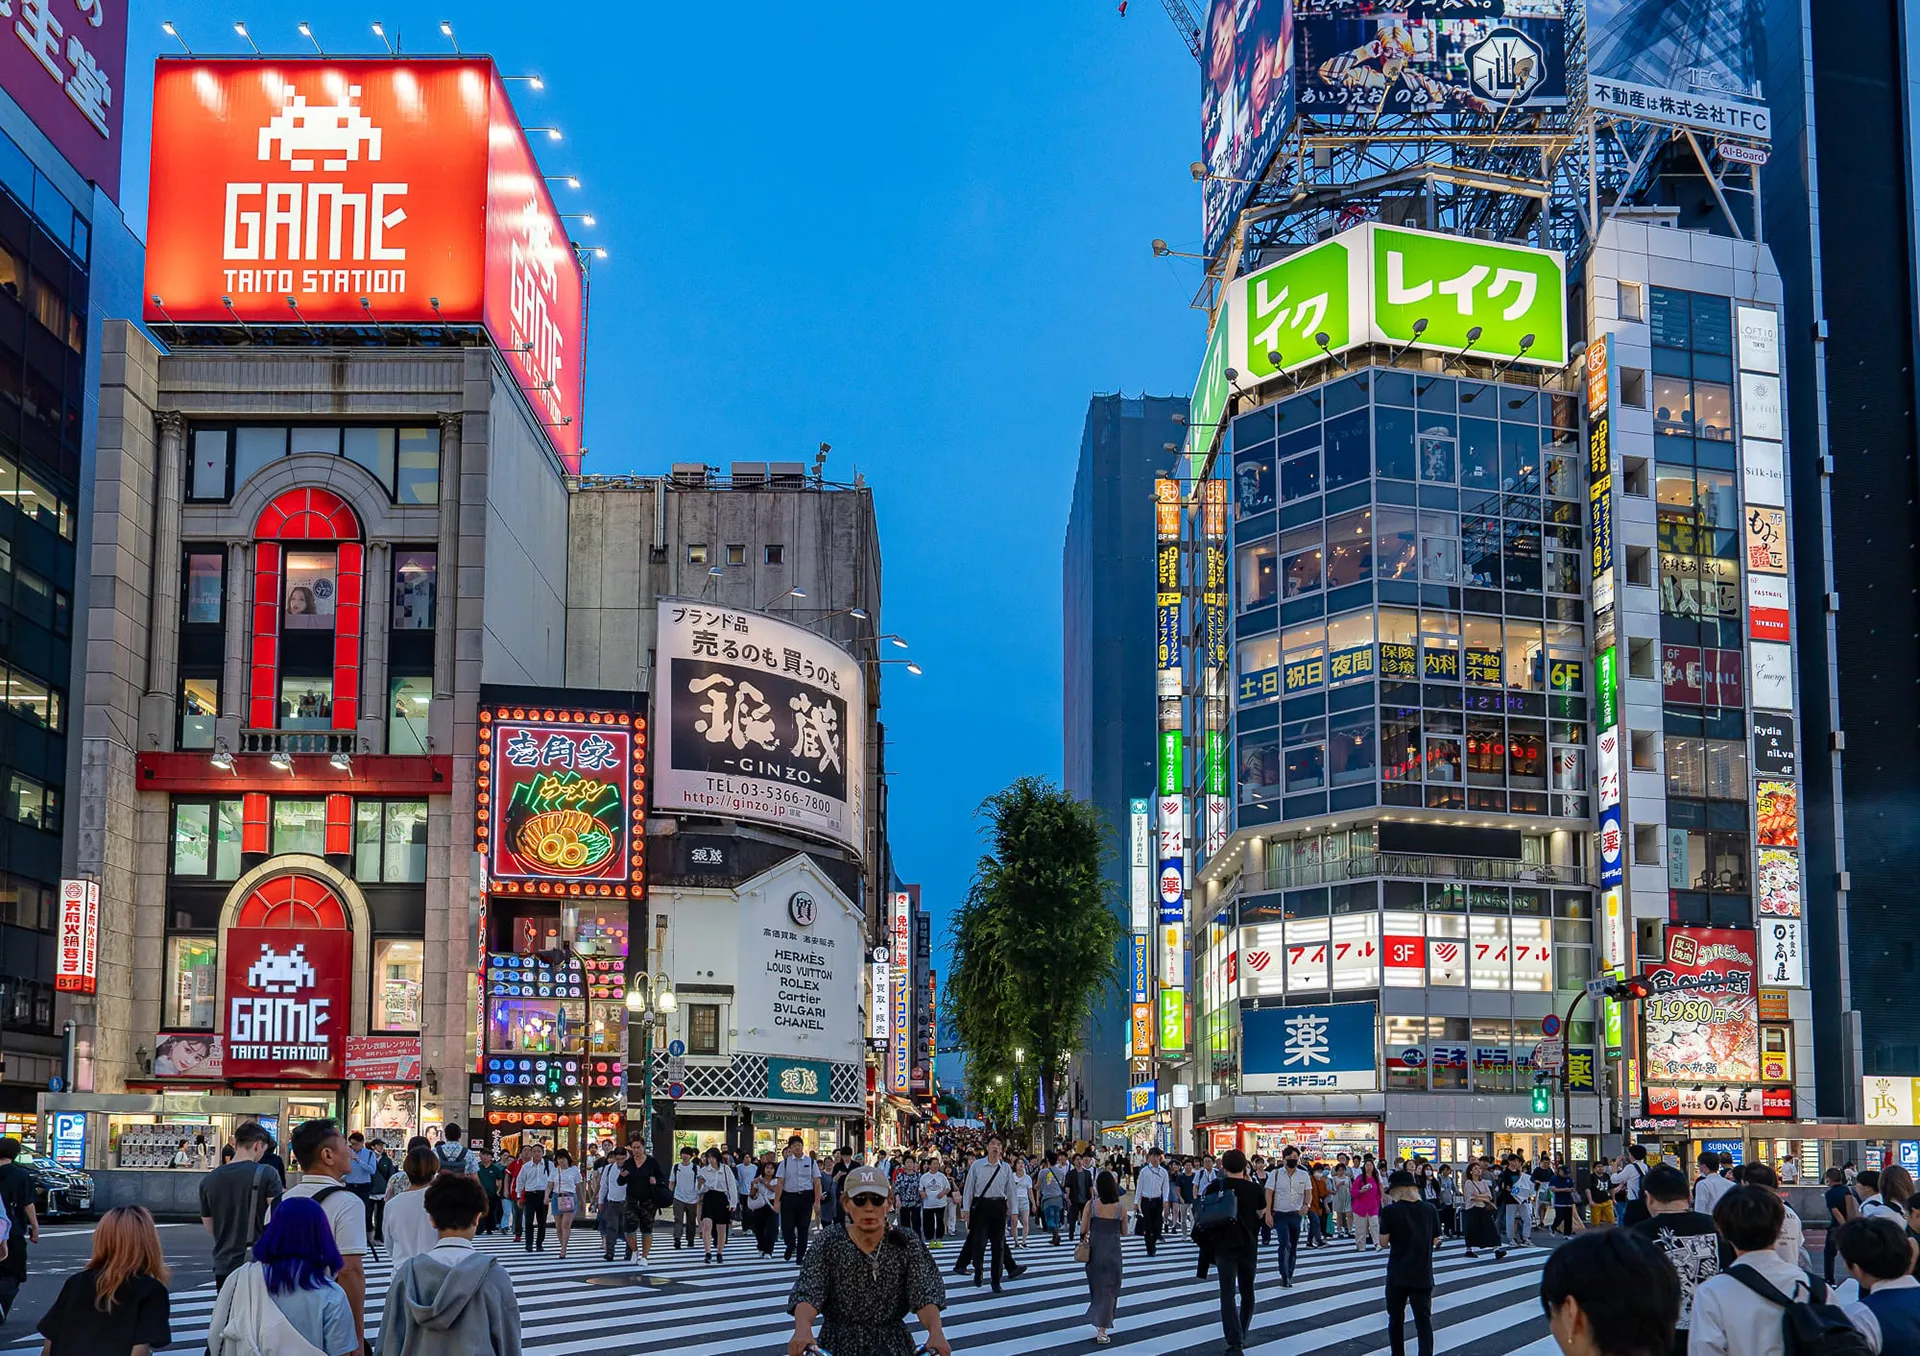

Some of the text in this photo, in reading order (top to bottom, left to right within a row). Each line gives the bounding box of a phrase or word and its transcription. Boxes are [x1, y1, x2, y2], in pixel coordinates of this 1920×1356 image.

[1594, 83, 1767, 131] 不動産は株式会社TFC
[223, 182, 408, 261] GAME
[224, 269, 405, 293] TAITO STATION
[1386, 250, 1538, 322] レイク
[510, 236, 563, 403] GAME
[1591, 429, 1600, 473] Table
[1599, 419, 1608, 472] Cheese
[1770, 512, 1783, 525] 7F
[1159, 550, 1168, 584] Table
[1169, 546, 1177, 588] Cheese
[1158, 594, 1169, 602] 7F
[671, 606, 750, 634] ブランド品
[691, 629, 840, 691] 売るのも 買うのも
[1381, 644, 1416, 660] 保険
[1466, 652, 1499, 668] 予約
[1667, 648, 1680, 660] 6F
[1286, 660, 1323, 688] 祝日
[1331, 650, 1373, 679] 夜間
[1381, 658, 1416, 675] 診療
[1424, 653, 1457, 675] 内科
[1466, 666, 1500, 682] 不要
[1550, 663, 1579, 687] 6F
[688, 673, 841, 775] 銀蔵
[1754, 725, 1782, 737] Rydia
[506, 729, 621, 771] 壱角家
[1766, 748, 1794, 759] niLva
[1781, 765, 1793, 774] 4F
[539, 776, 607, 802] ラーメン
[706, 777, 831, 814] TEL.03-5366-7800
[683, 790, 785, 816] http://ginzo.jp
[1603, 828, 1619, 854] 薬
[1162, 876, 1180, 894] 薬
[795, 897, 813, 921] 質
[63, 899, 81, 972] 天府火鍋巷子
[897, 915, 908, 939] 免税
[774, 949, 825, 966] HERMÈS
[1288, 941, 1375, 966] アイフル
[1393, 944, 1415, 962] 3F
[1475, 943, 1550, 962] アイフル
[1773, 924, 1790, 982] 日高屋
[766, 961, 833, 981] LOUIS VUITTON
[58, 978, 81, 989] B1F
[780, 977, 820, 991] ROLEX
[778, 990, 822, 1005] Cartier
[230, 997, 331, 1043] GAME
[773, 1002, 826, 1018] BVLGARI
[1165, 997, 1179, 1040] レイク
[774, 1016, 825, 1031] CHANEL
[1283, 1015, 1330, 1067] 薬
[230, 1044, 328, 1061] TAITO STATION
[1432, 1047, 1539, 1066] ミネドラッ
[1277, 1075, 1338, 1088] ミネドラッグ
[1704, 1092, 1751, 1113] 日高屋
[1763, 1098, 1791, 1108] 深夜食堂
[60, 1118, 73, 1137] P
[1902, 1146, 1911, 1161] P
[860, 1172, 875, 1183] M
